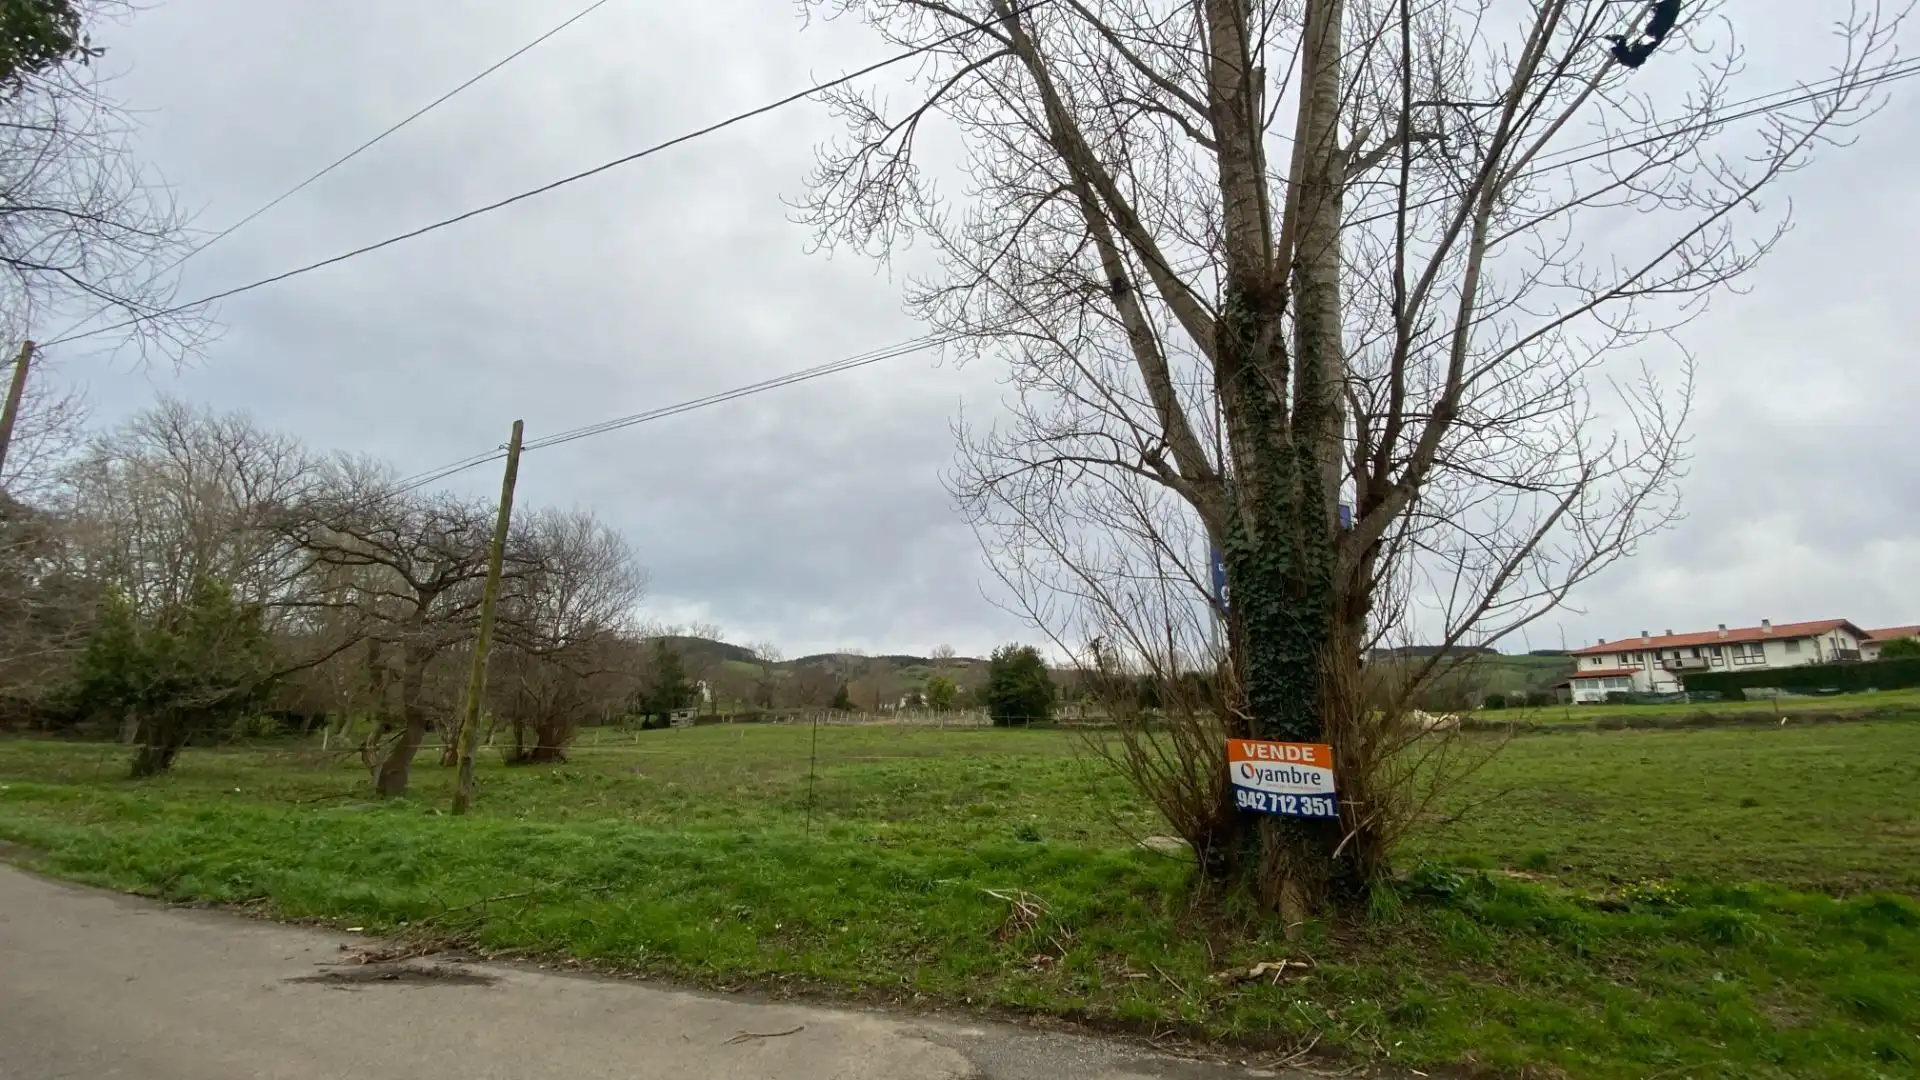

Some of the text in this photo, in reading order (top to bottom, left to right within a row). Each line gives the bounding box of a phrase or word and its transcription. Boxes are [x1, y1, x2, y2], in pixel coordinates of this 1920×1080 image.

[1242, 743, 1315, 762] VENDE
[1241, 763, 1321, 786] Oyambre
[1237, 790, 1334, 816] 942 712 351
